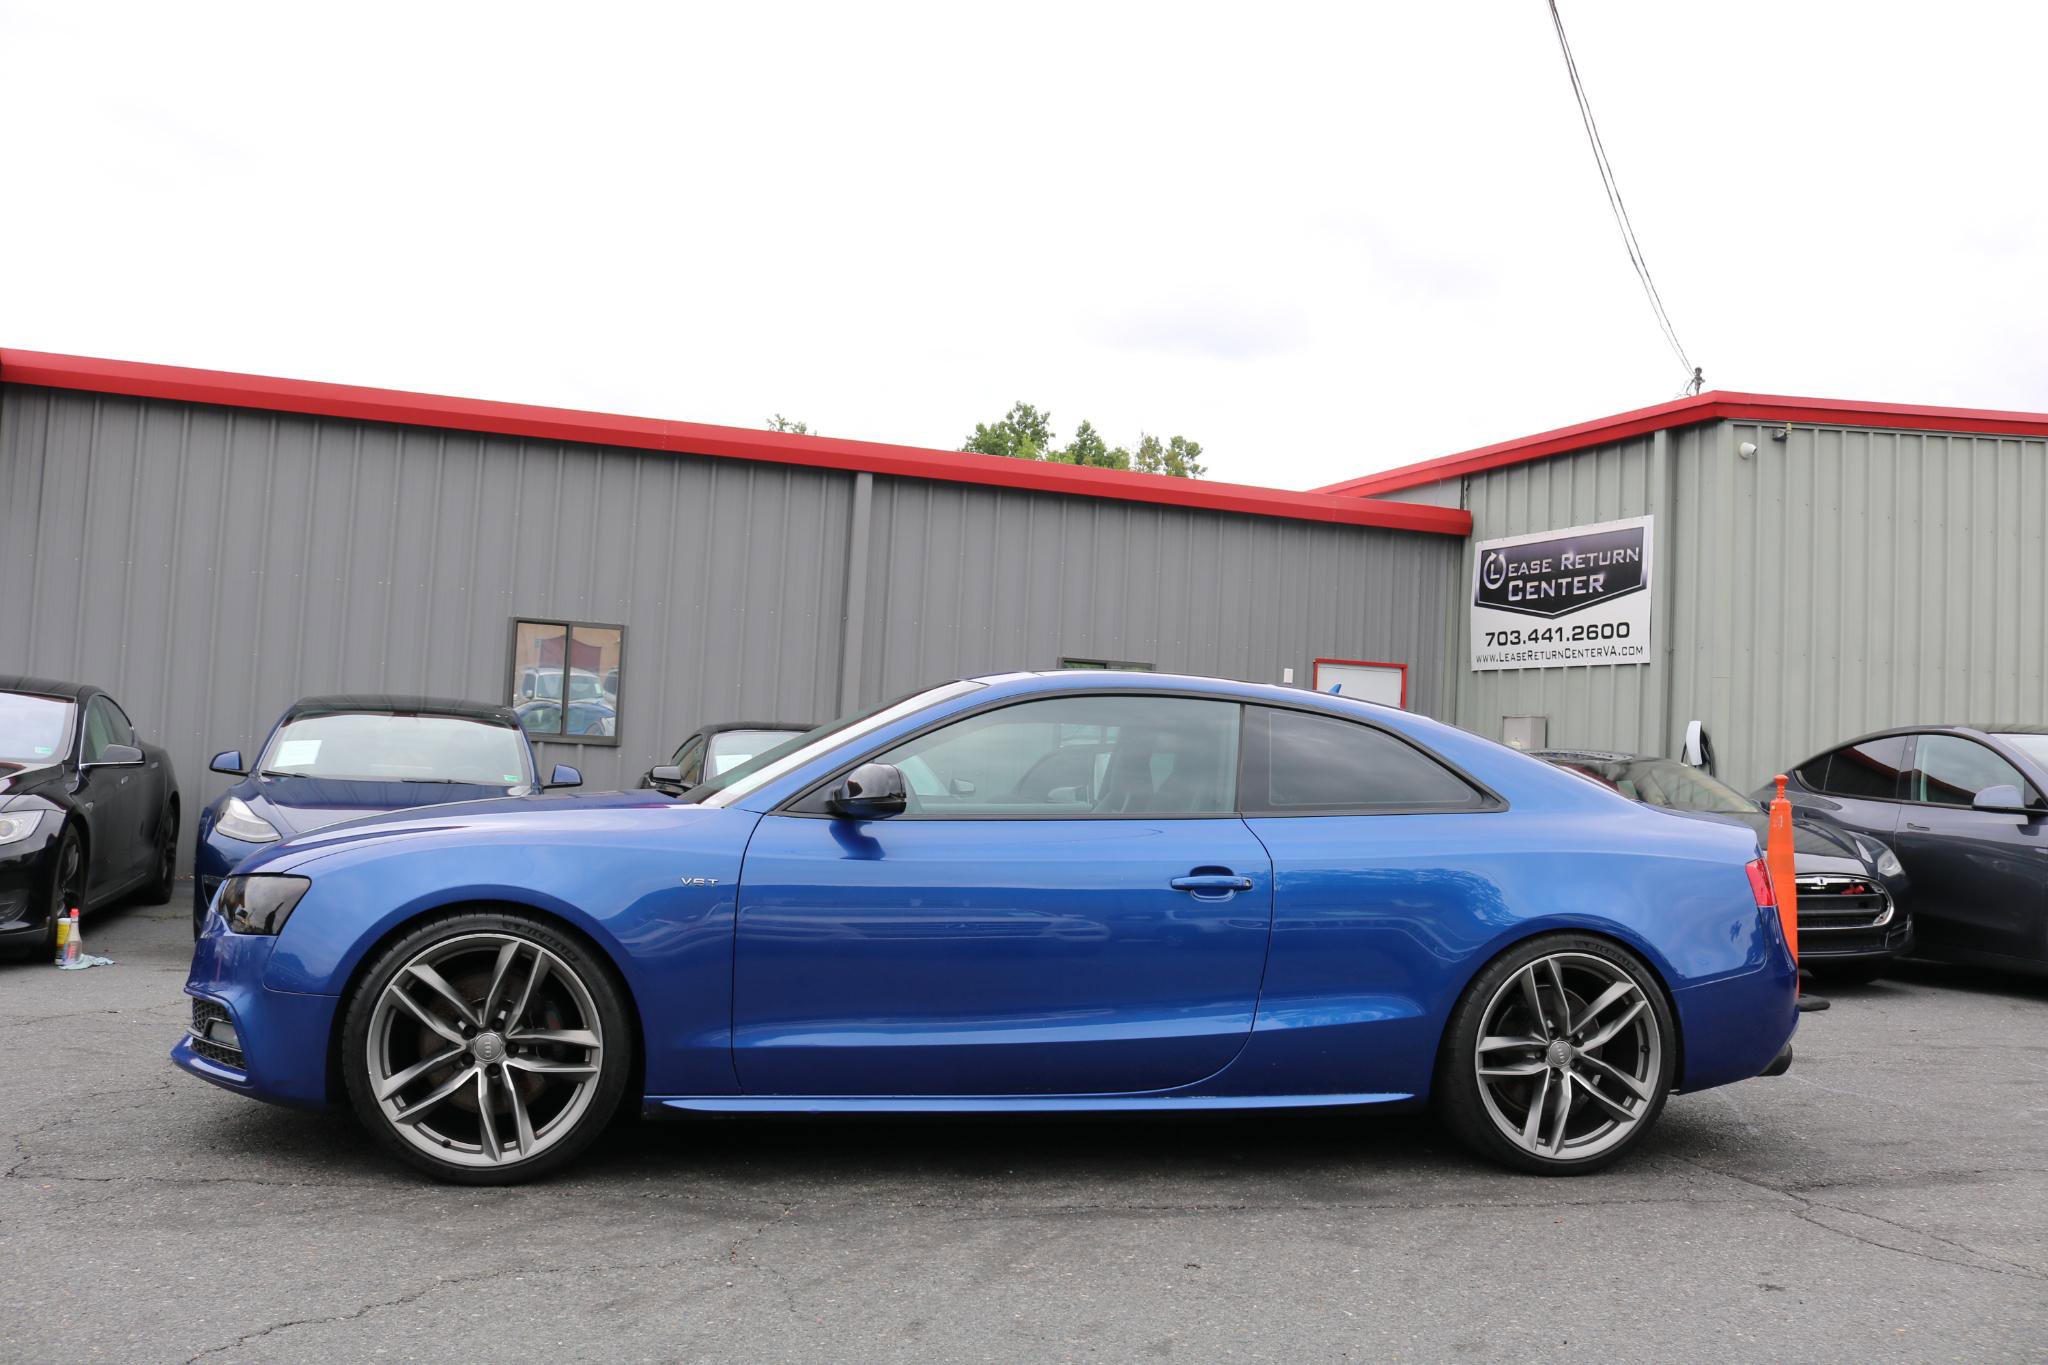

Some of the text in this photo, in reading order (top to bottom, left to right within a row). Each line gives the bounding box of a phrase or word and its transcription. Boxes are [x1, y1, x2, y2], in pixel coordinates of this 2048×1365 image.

[1489, 547, 1639, 581] LEASE RETURN
[1508, 575, 1604, 602] CENTER
[1485, 622, 1630, 647] 703.441.2600
[1476, 646, 1643, 664] WWW.LEASERETURNCENTERVA.COM
